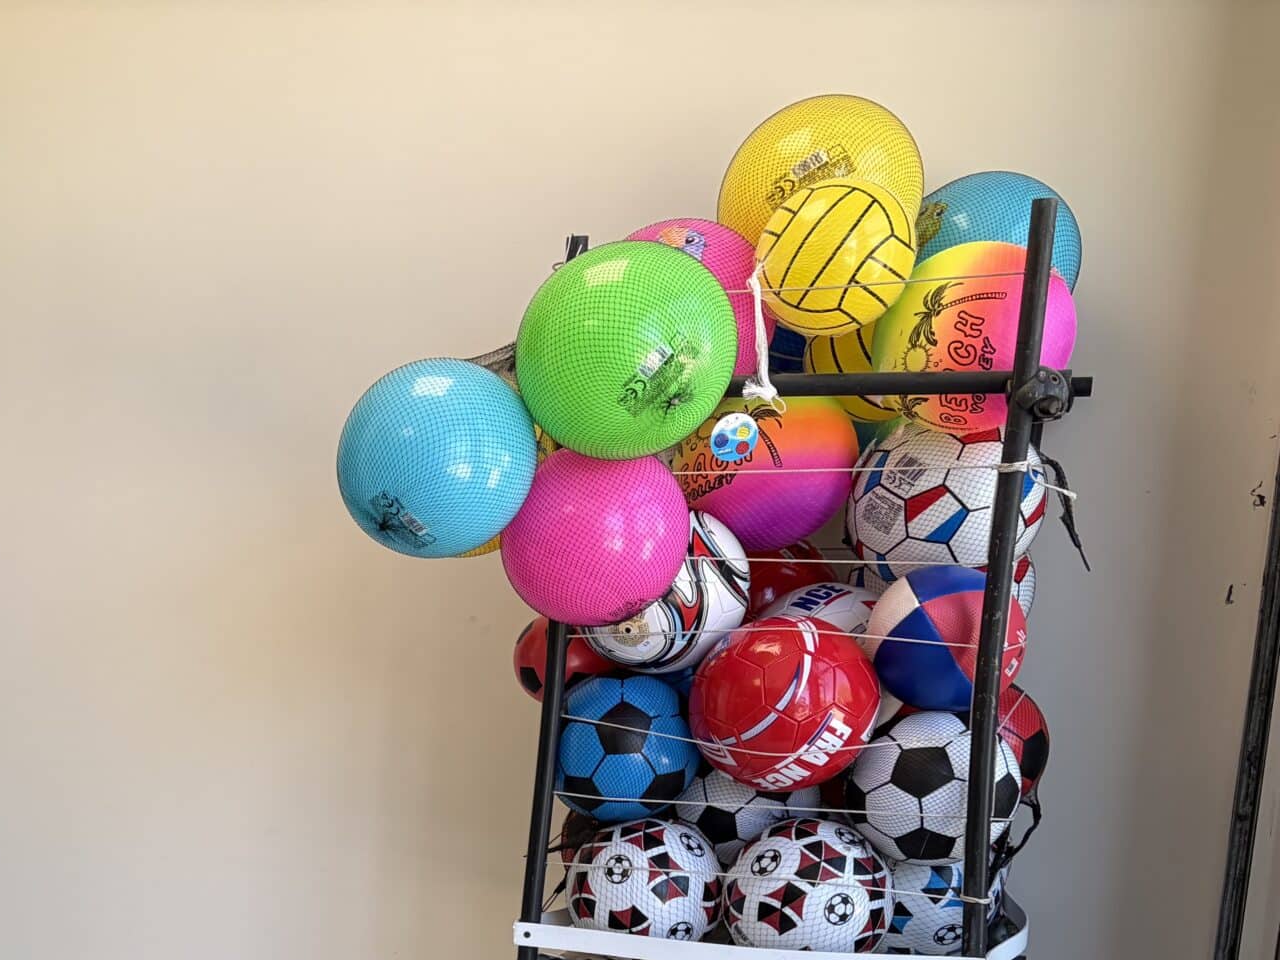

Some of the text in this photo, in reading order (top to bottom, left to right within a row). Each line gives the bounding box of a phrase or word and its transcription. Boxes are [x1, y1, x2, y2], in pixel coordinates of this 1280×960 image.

[939, 310, 986, 426] BECH
[969, 336, 997, 414] VOEY
[751, 710, 853, 791] FRANCE
